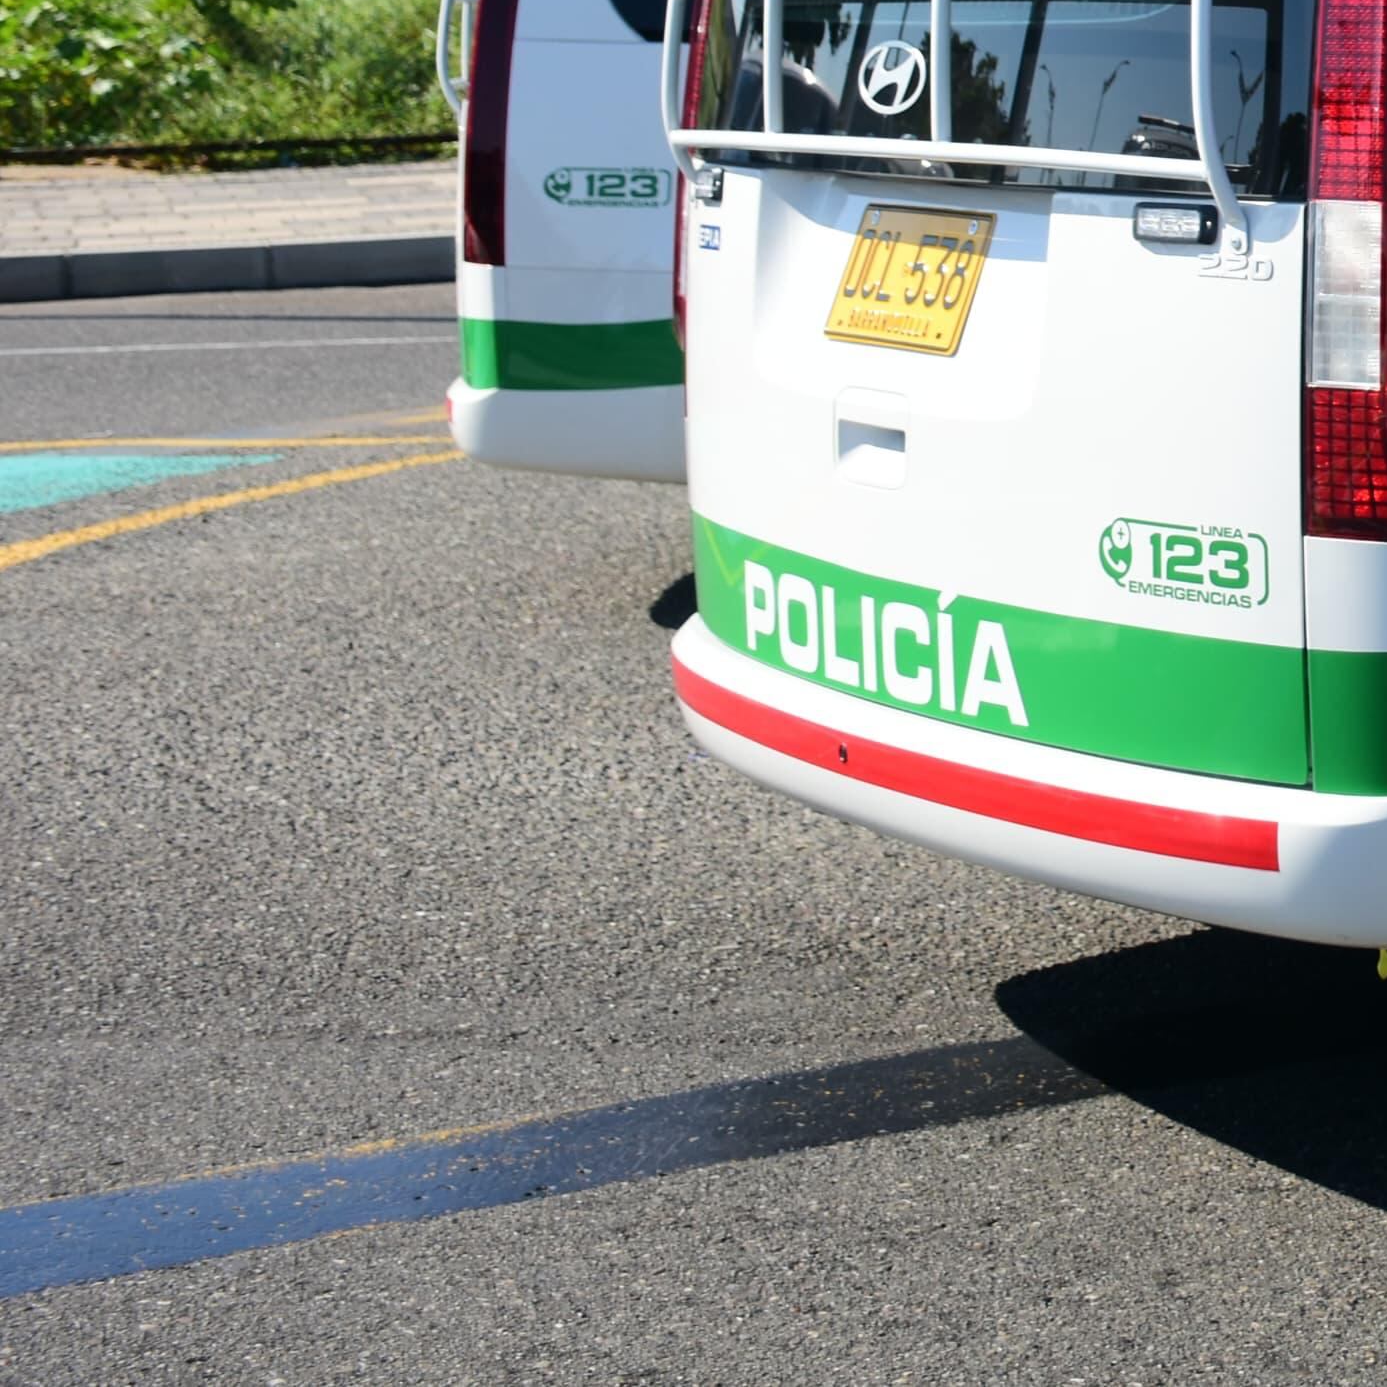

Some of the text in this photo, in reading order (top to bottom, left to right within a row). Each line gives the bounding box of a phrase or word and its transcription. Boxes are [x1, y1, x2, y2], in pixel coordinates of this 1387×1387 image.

[586, 173, 659, 198] 123
[904, 234, 975, 311] 538
[1200, 524, 1244, 540] LINEA
[1149, 532, 1250, 590] 123
[1128, 579, 1253, 609] EMERGENCIAS
[743, 559, 1029, 728] POLICÍA
